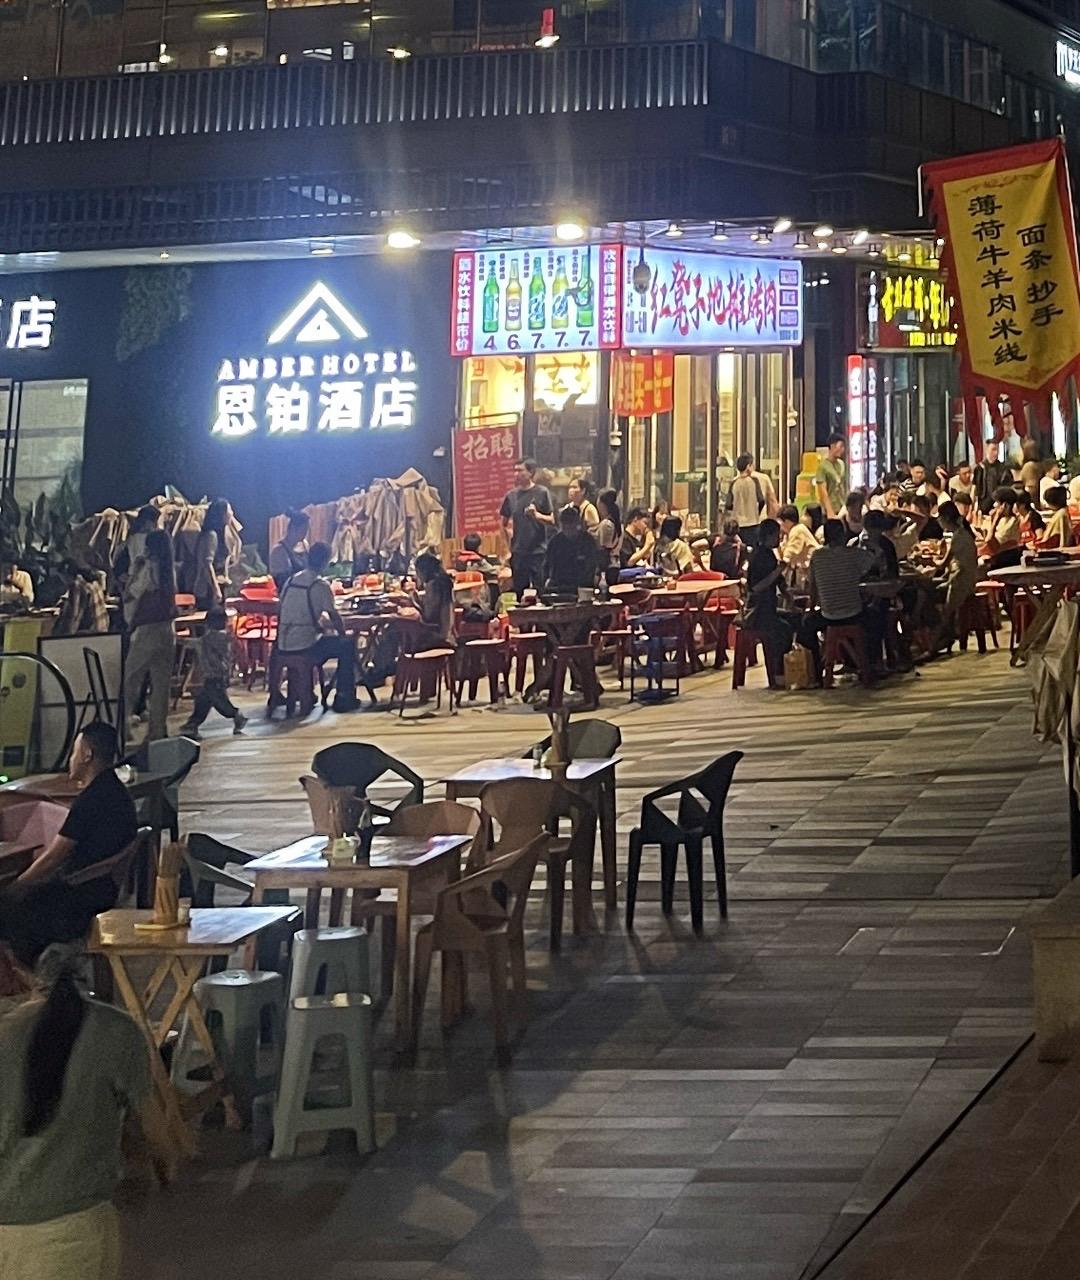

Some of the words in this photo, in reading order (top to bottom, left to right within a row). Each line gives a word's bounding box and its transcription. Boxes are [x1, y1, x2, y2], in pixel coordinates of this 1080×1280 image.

[968, 194, 1028, 367] 薄荷牛羊肉米线
[217, 357, 315, 382] AMBER
[321, 350, 416, 376] HOTEL
[210, 377, 418, 436] 恩铂酒店
[461, 431, 516, 462] 招聘
